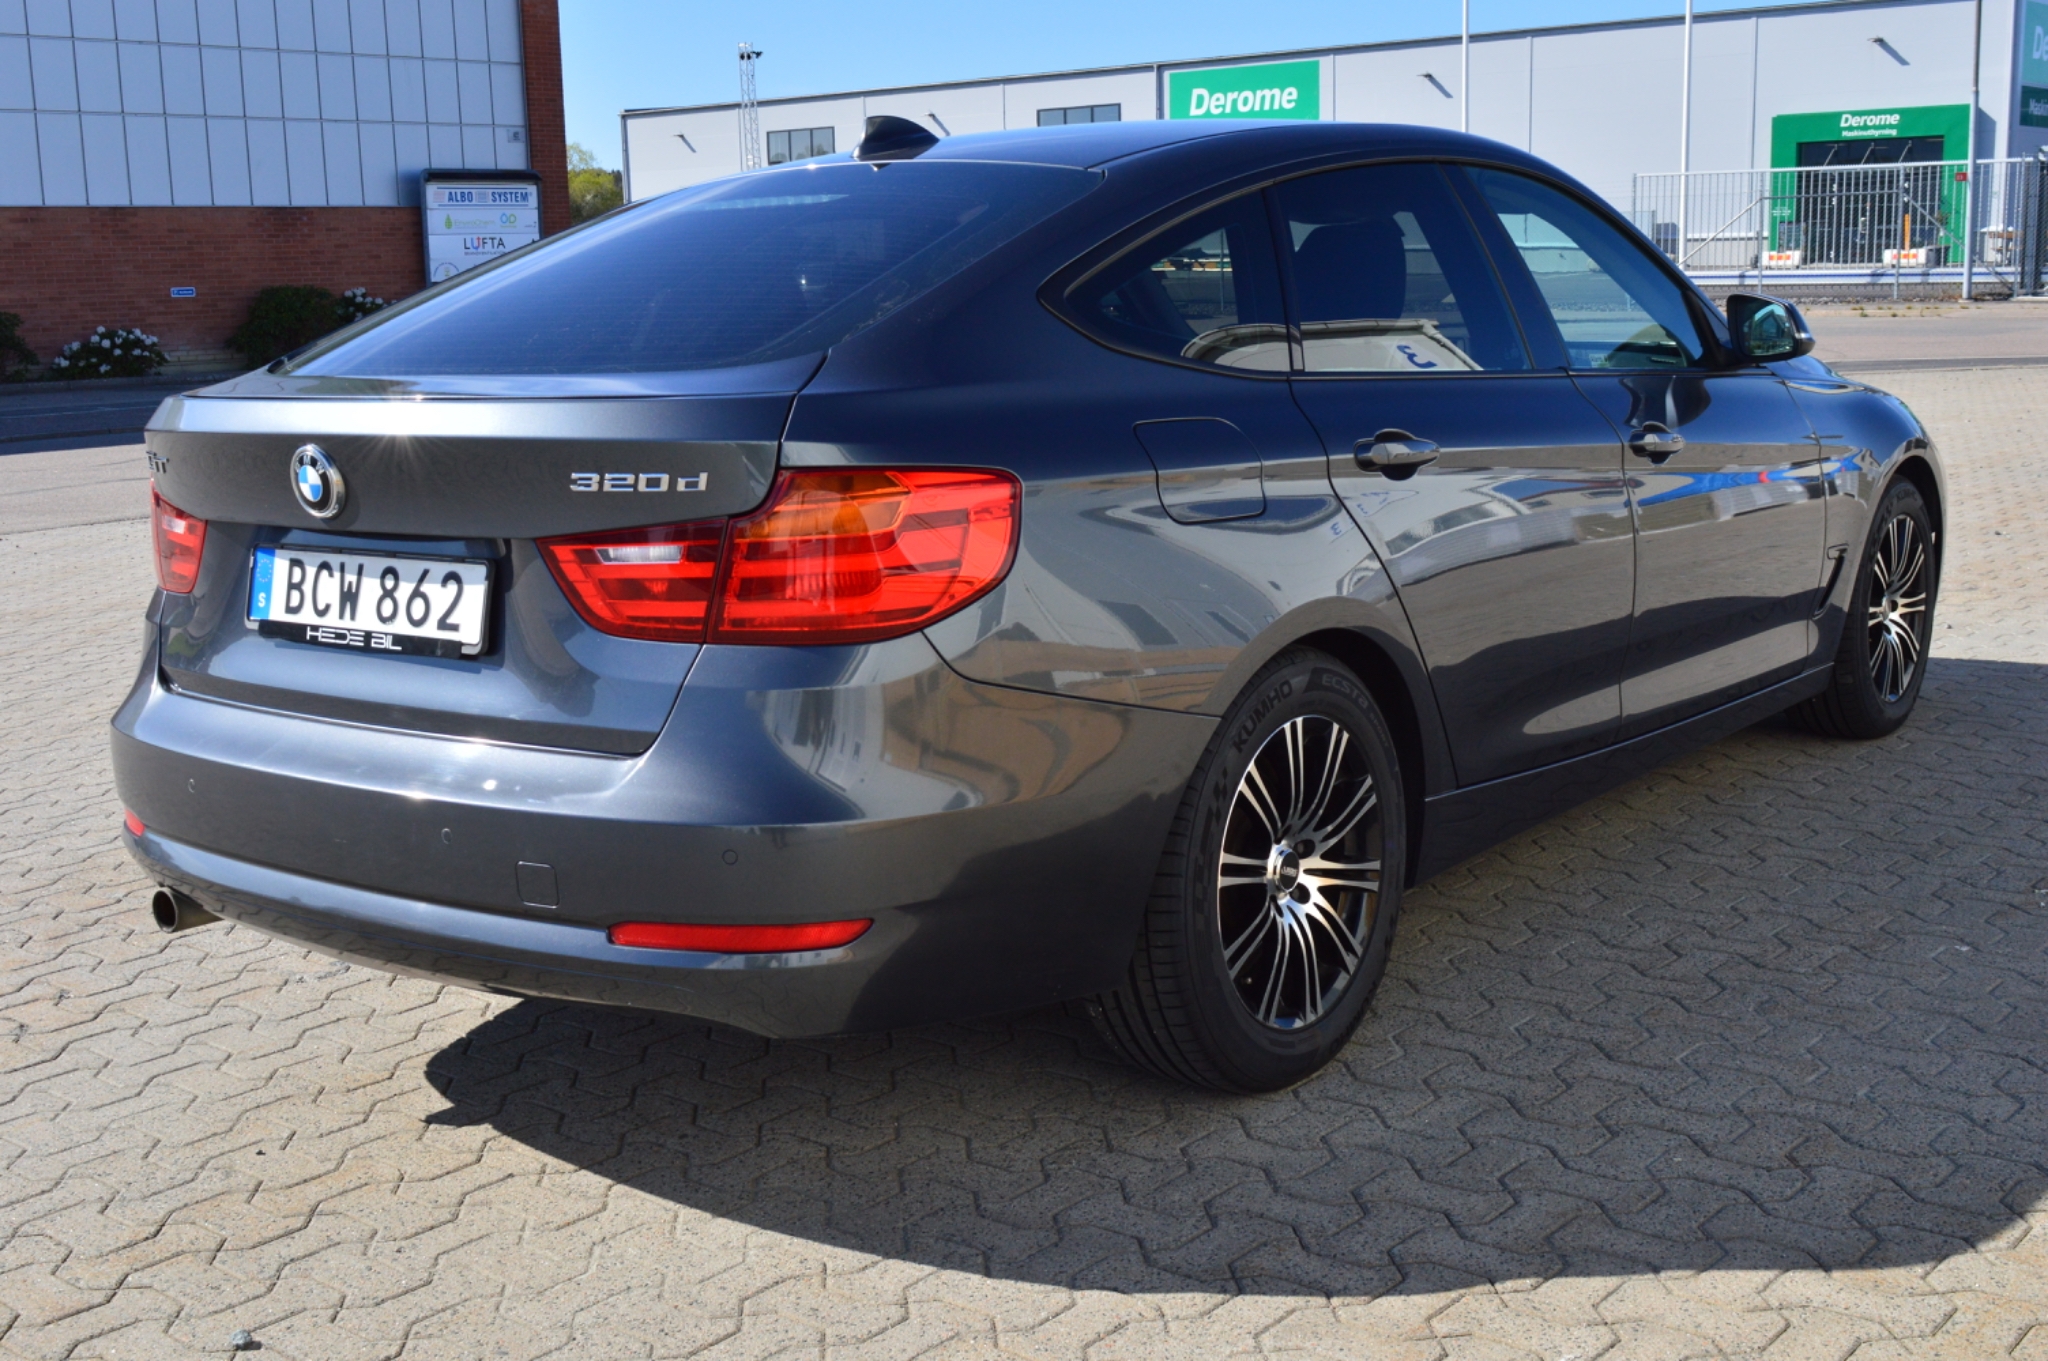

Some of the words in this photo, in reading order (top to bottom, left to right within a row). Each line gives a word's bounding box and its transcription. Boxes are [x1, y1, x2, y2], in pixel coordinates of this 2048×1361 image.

[1189, 86, 1298, 116] Derome
[1840, 113, 1900, 127] Derome
[1842, 128, 1897, 137] Maskinuthyrning
[447, 191, 473, 203] ALBO
[491, 191, 529, 203] SYSTEM
[464, 236, 506, 251] LUFTA
[257, 592, 267, 608] S
[284, 557, 364, 622] BCW
[375, 565, 465, 633] 862
[306, 626, 365, 648] HEDE
[371, 632, 403, 651] BIL
[1230, 679, 1294, 754] KUMHO
